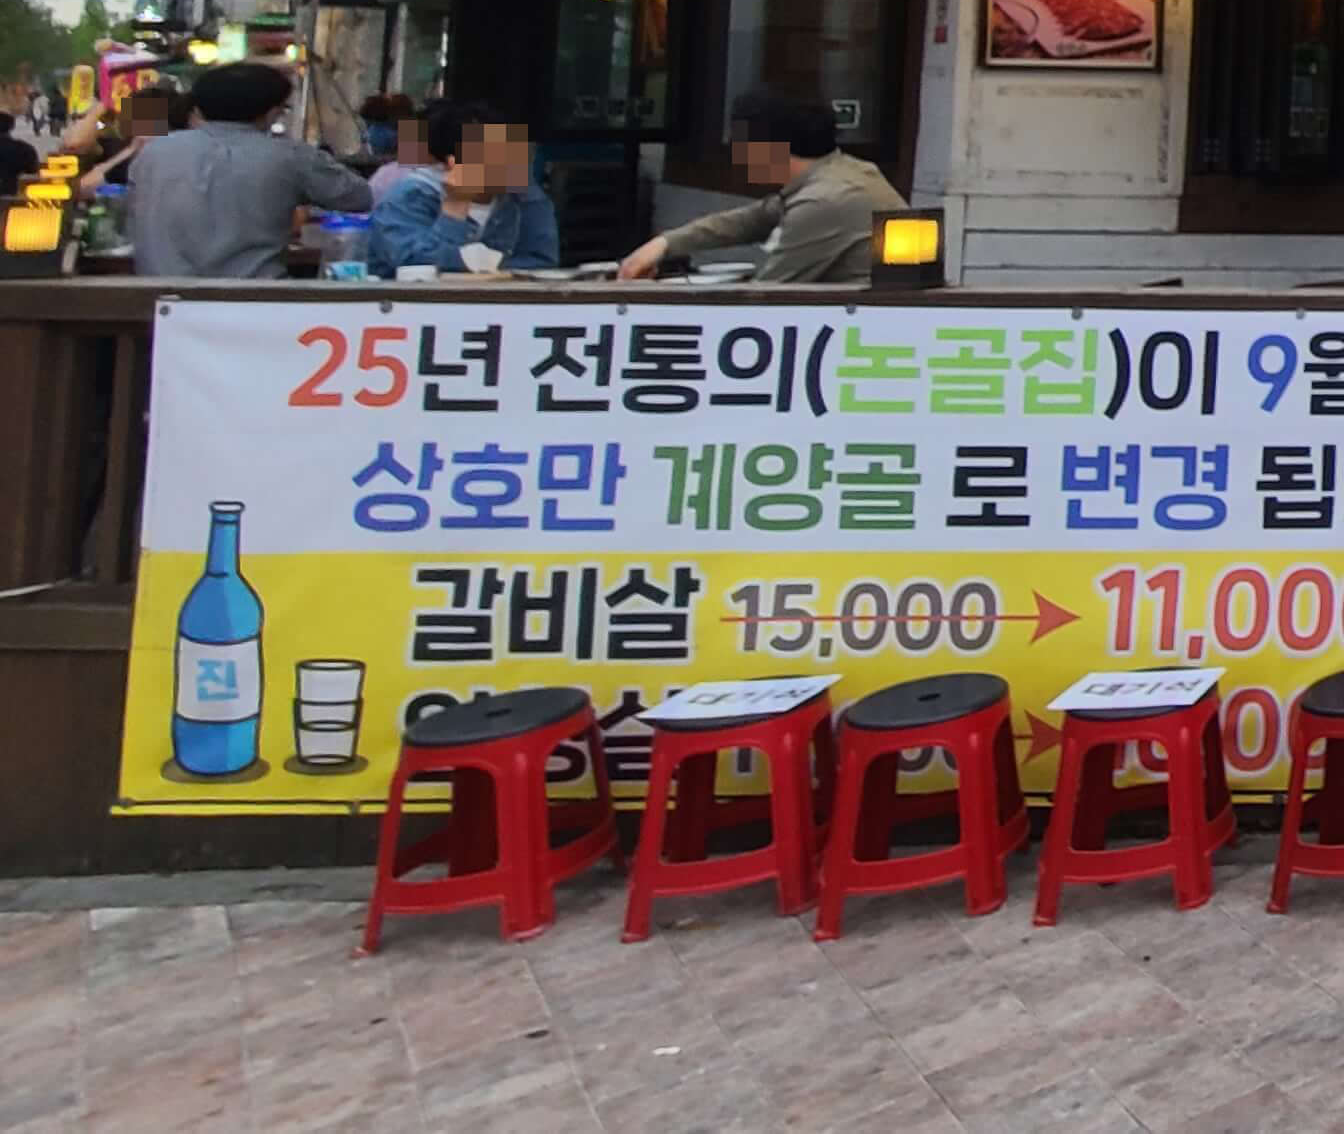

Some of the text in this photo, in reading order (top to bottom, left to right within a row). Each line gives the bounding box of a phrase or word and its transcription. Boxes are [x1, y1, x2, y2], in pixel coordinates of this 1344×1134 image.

[287, 324, 502, 414] 25년
[529, 323, 1219, 420] 전통의(논골집)이
[352, 441, 628, 533] 상호만
[653, 441, 922, 532] 계양골
[945, 444, 1031, 529] 로
[1062, 442, 1231, 531] 변경
[410, 566, 701, 663] 갈비살
[728, 580, 998, 659] 15,000
[195, 658, 240, 703] 진
